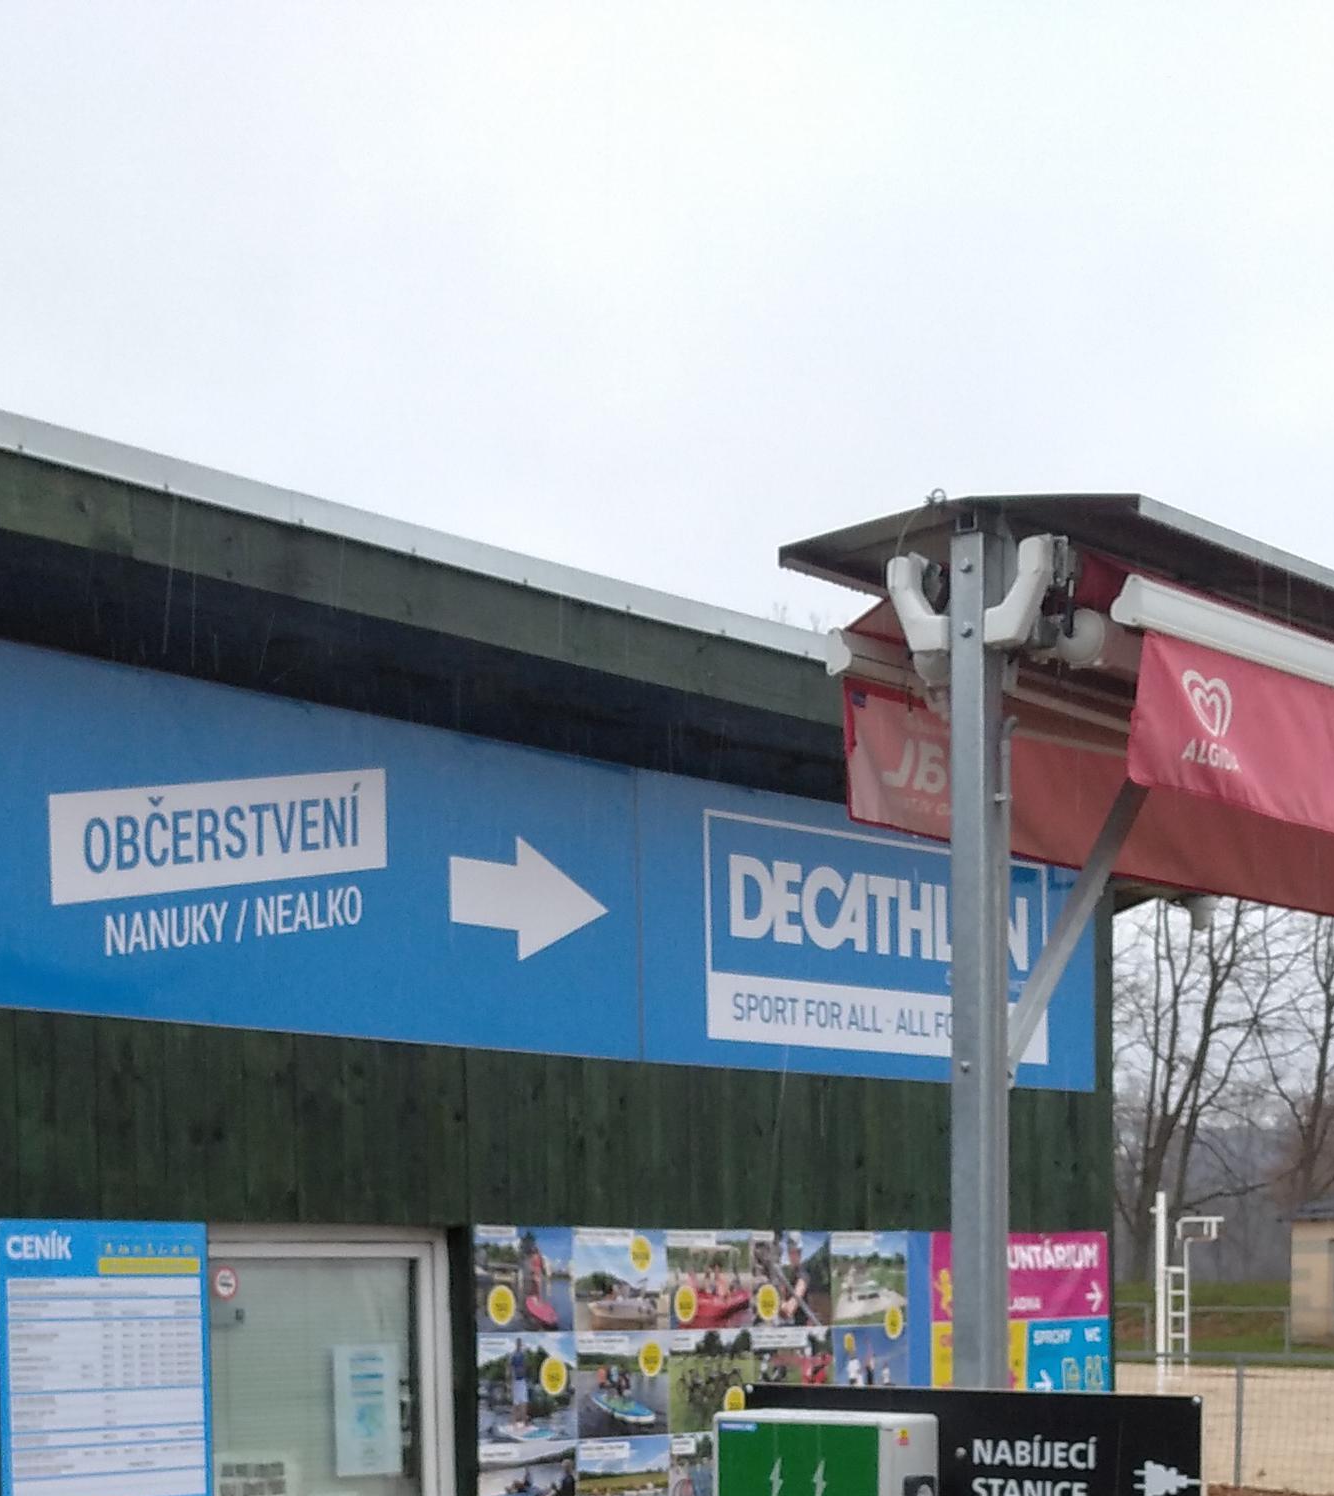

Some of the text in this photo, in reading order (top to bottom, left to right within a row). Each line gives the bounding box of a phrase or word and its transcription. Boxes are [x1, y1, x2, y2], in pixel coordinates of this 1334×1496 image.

[84, 783, 360, 875] OBČERSTVENÍ
[105, 902, 227, 957] NANUKY
[256, 886, 363, 937] NEALKO
[728, 853, 1029, 972] DECATHLN
[732, 991, 798, 1026] SPORT
[804, 999, 843, 1031] FOR
[847, 1003, 882, 1034] ALL
[895, 1008, 930, 1038] ALL
[934, 1011, 953, 1039] FO
[6, 1230, 72, 1260] CENÍK
[1006, 1238, 1099, 1270] UNTÁRIUM
[972, 1433, 1097, 1470] NABÍJECÍ
